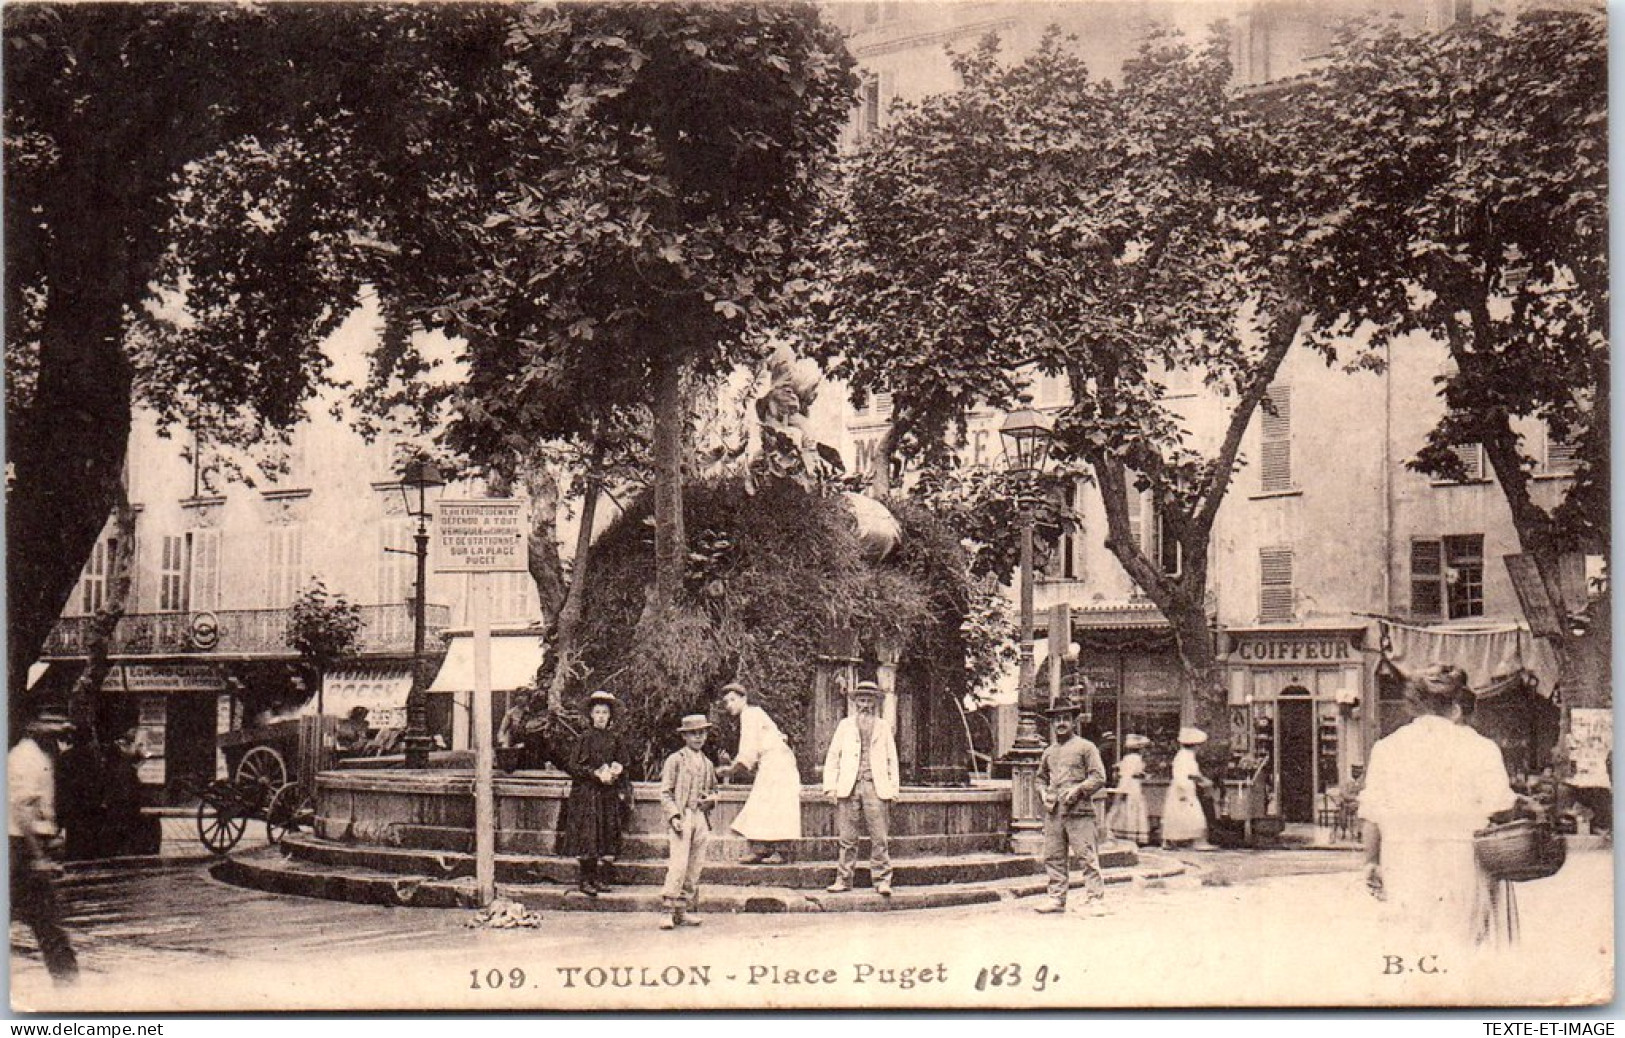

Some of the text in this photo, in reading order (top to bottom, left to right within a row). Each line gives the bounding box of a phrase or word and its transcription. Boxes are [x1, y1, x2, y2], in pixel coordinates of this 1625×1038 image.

[493, 517, 518, 525] TOUT
[442, 537, 453, 546] ET
[450, 547, 514, 556] SUR LA PLACE
[465, 556, 496, 565] PUGET
[1239, 640, 1350, 660] COIFFEUR
